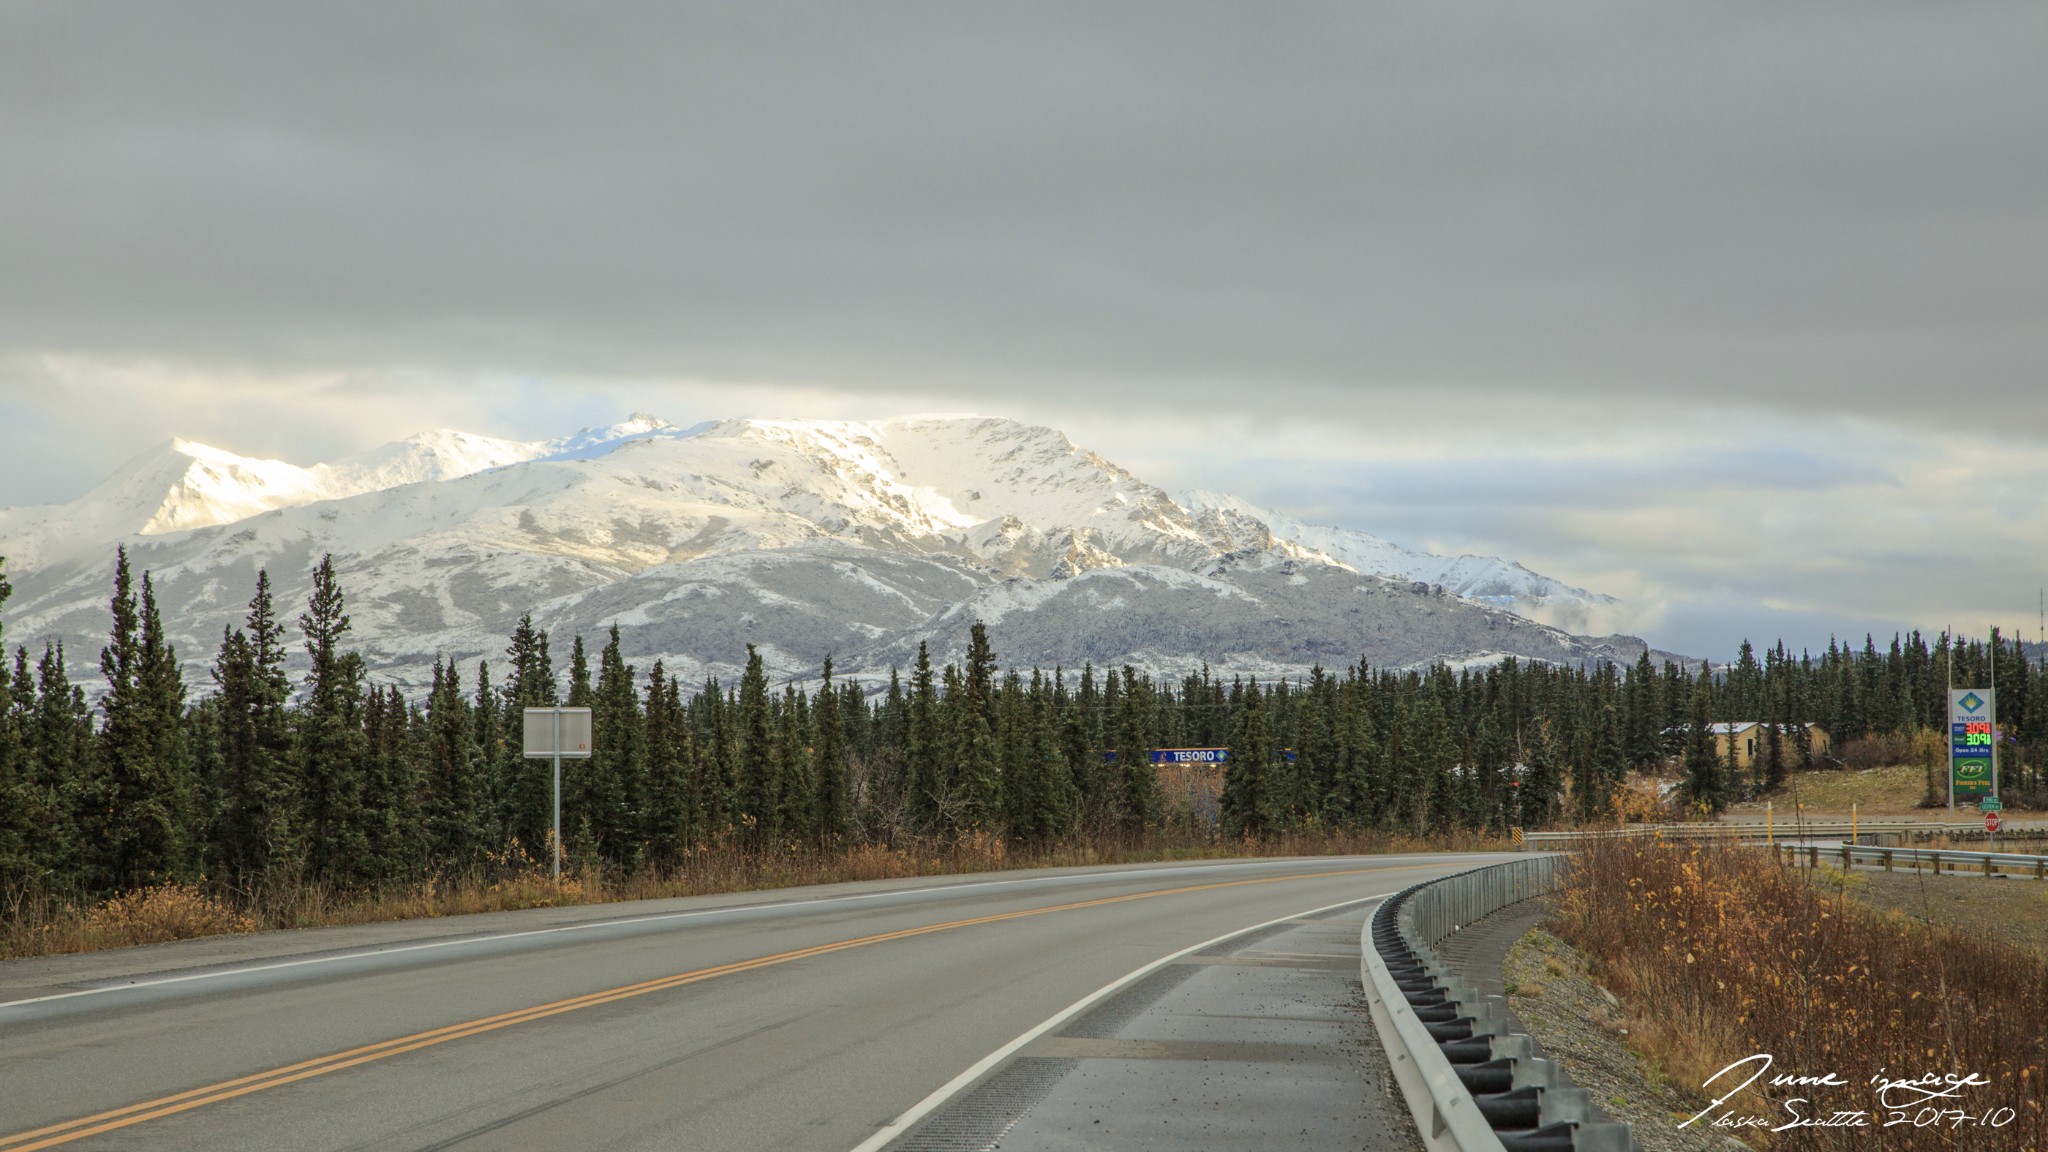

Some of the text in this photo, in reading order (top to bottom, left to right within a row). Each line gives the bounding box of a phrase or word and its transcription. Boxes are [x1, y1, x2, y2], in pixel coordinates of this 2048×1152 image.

[1174, 751, 1214, 761] TESORO
[1960, 765, 1984, 773] FFI
[1986, 818, 1998, 826] STOP
